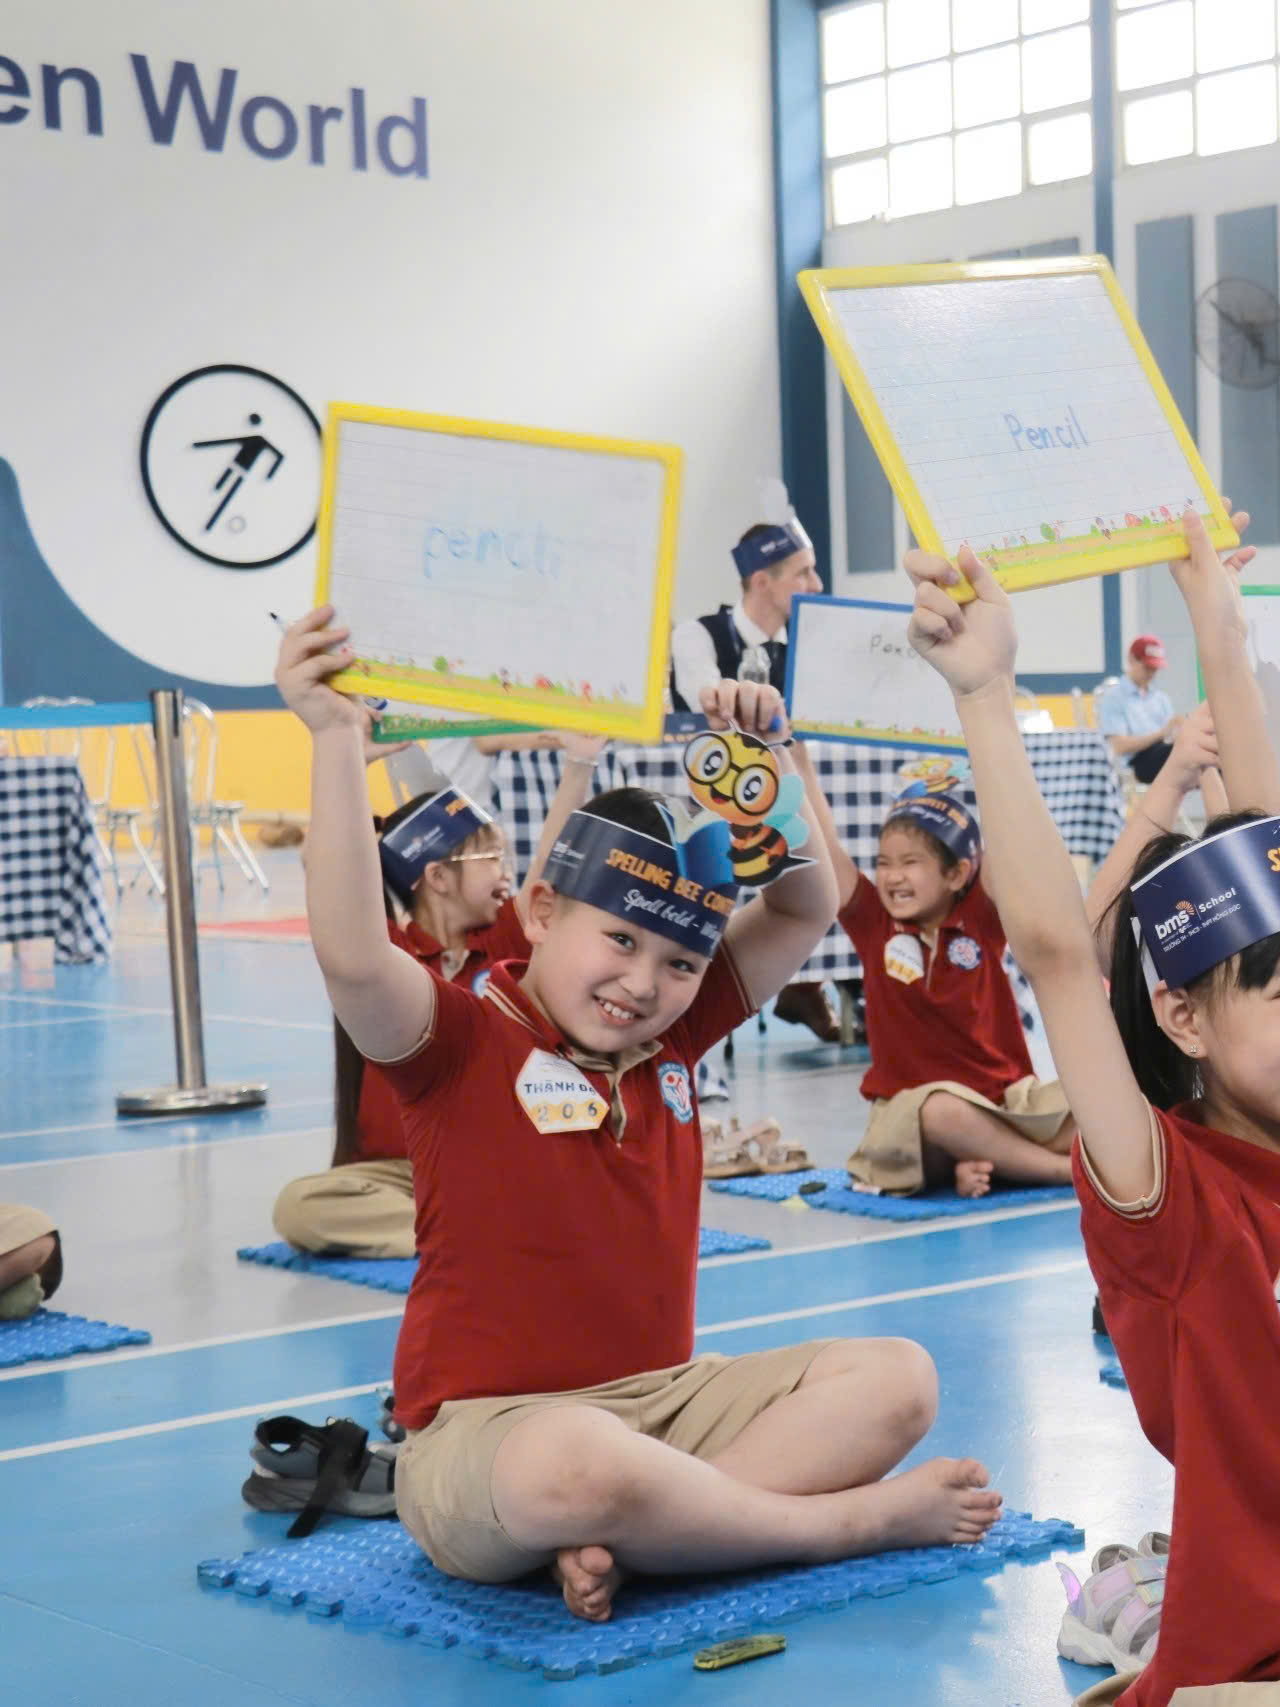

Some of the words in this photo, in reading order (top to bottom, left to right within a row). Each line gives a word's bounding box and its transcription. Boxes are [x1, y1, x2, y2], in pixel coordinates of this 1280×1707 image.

[128, 53, 430, 180] World
[1003, 404, 1089, 452] Pencil
[605, 848, 673, 890] SPELLING
[673, 876, 704, 902] BEE
[1155, 910, 1190, 940] bms
[1198, 887, 1237, 913] School
